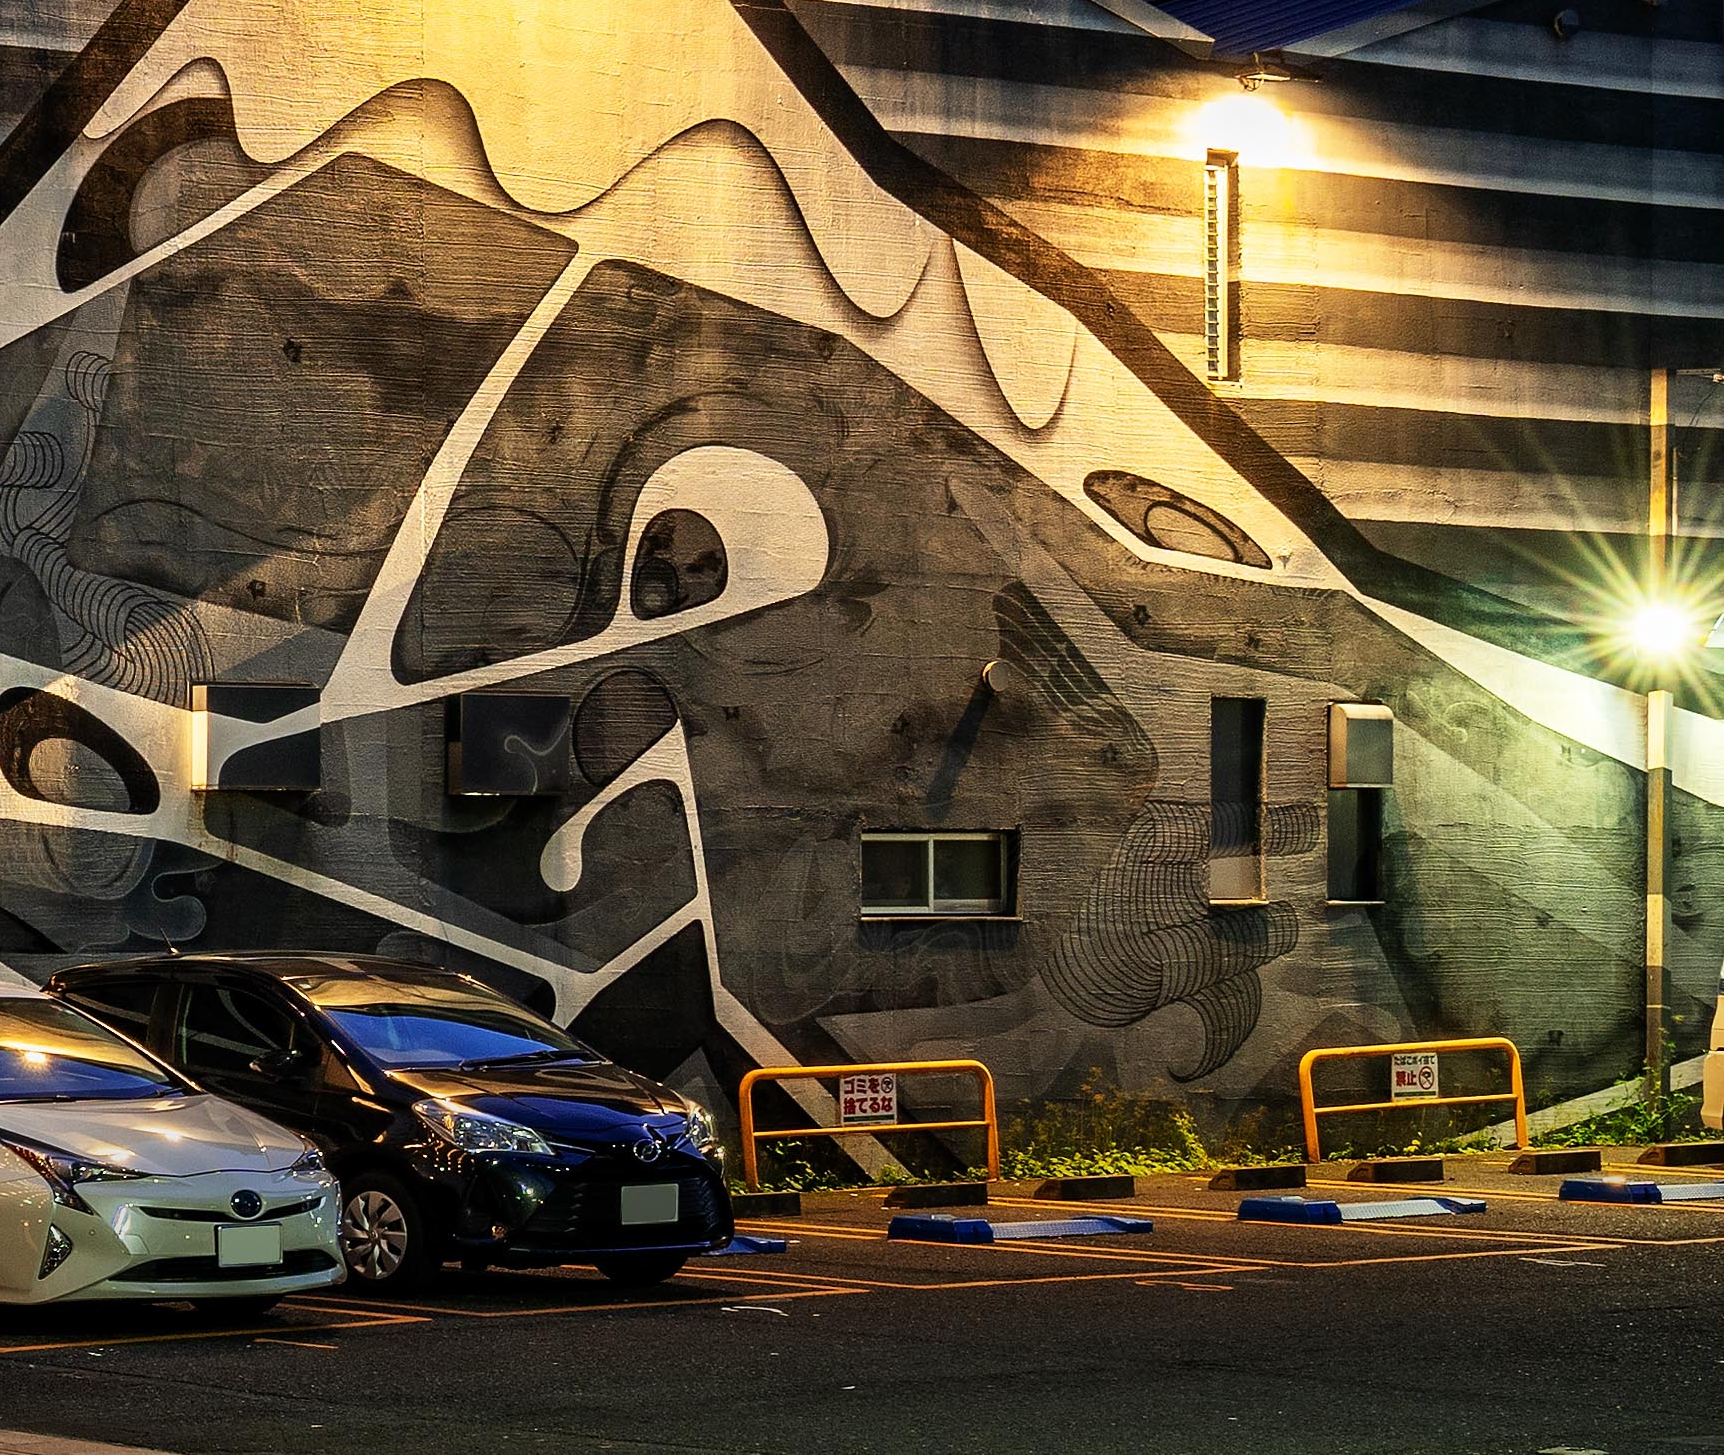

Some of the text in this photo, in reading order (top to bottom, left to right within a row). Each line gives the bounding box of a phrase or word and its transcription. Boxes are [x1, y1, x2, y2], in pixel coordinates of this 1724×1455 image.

[843, 1076, 880, 1095] ゴミを
[1395, 1070, 1417, 1087] 禁止
[843, 1095, 893, 1116] 捨てるな
